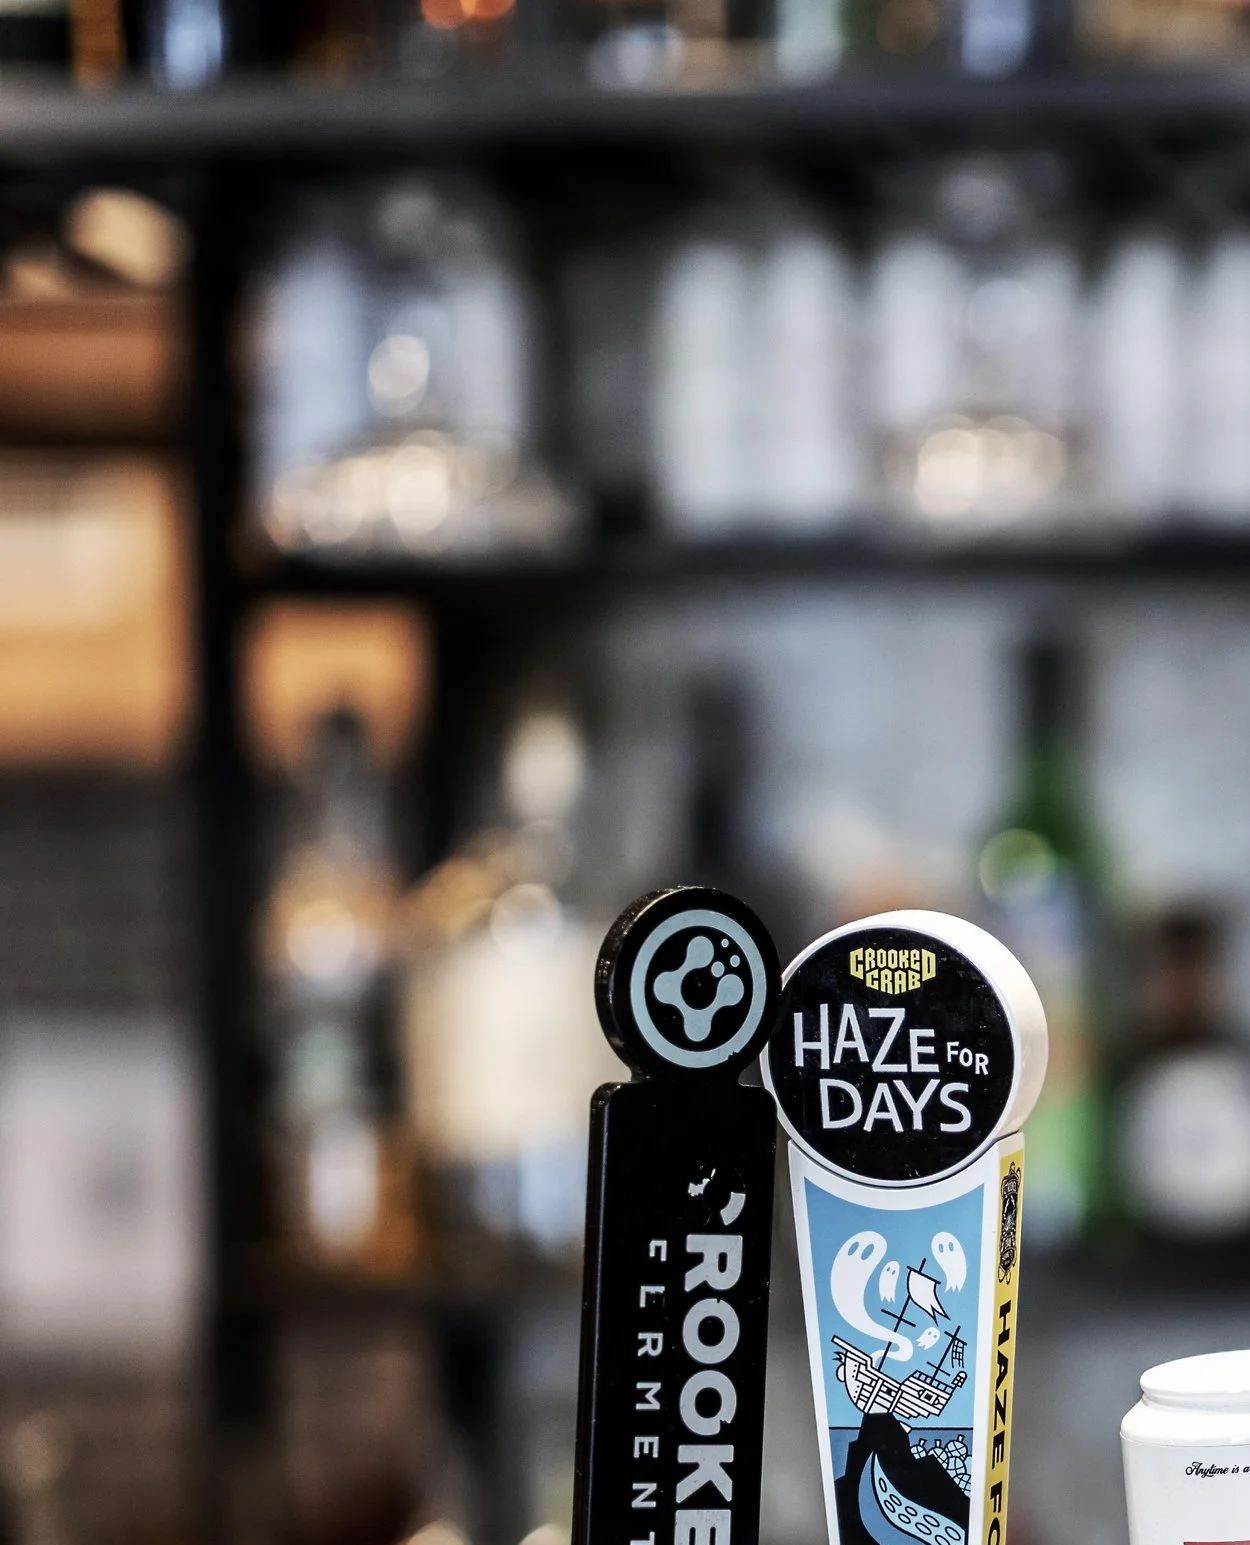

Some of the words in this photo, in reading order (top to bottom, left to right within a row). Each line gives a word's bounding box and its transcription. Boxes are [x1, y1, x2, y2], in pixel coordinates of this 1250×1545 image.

[866, 970, 921, 995] CRAB
[793, 1003, 940, 1073] HAZE
[946, 1041, 989, 1075] FOR
[819, 1078, 972, 1133] DAYS
[992, 1300, 1012, 1470] HAZE
[1185, 1461, 1229, 1478] Anytime
[1231, 1464, 1240, 1474] is
